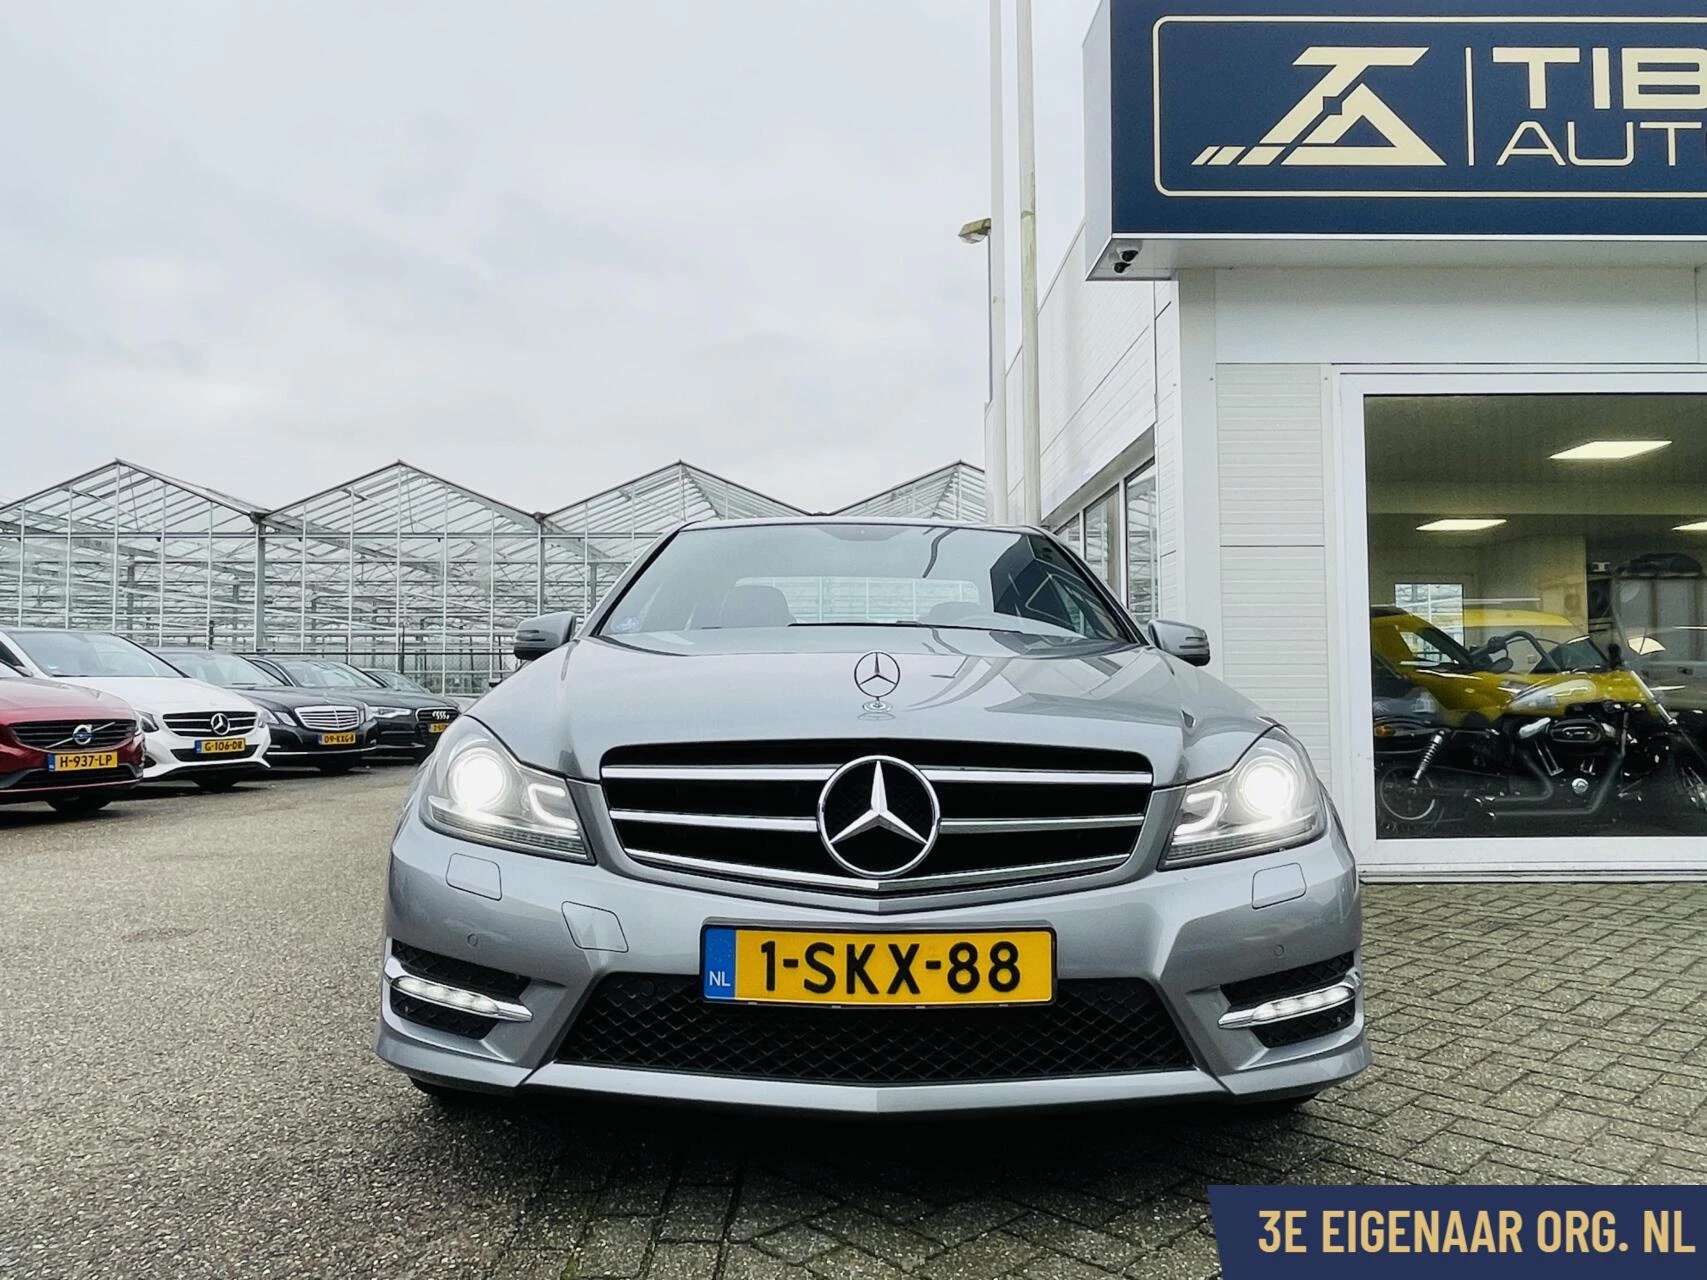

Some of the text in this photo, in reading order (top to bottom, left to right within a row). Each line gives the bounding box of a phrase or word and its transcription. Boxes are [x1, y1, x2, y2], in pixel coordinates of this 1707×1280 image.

[1492, 47, 1707, 109] TIB
[60, 755, 112, 768] H-937-LP
[709, 970, 731, 987] NL
[760, 940, 1021, 995] 1-SKX-88
